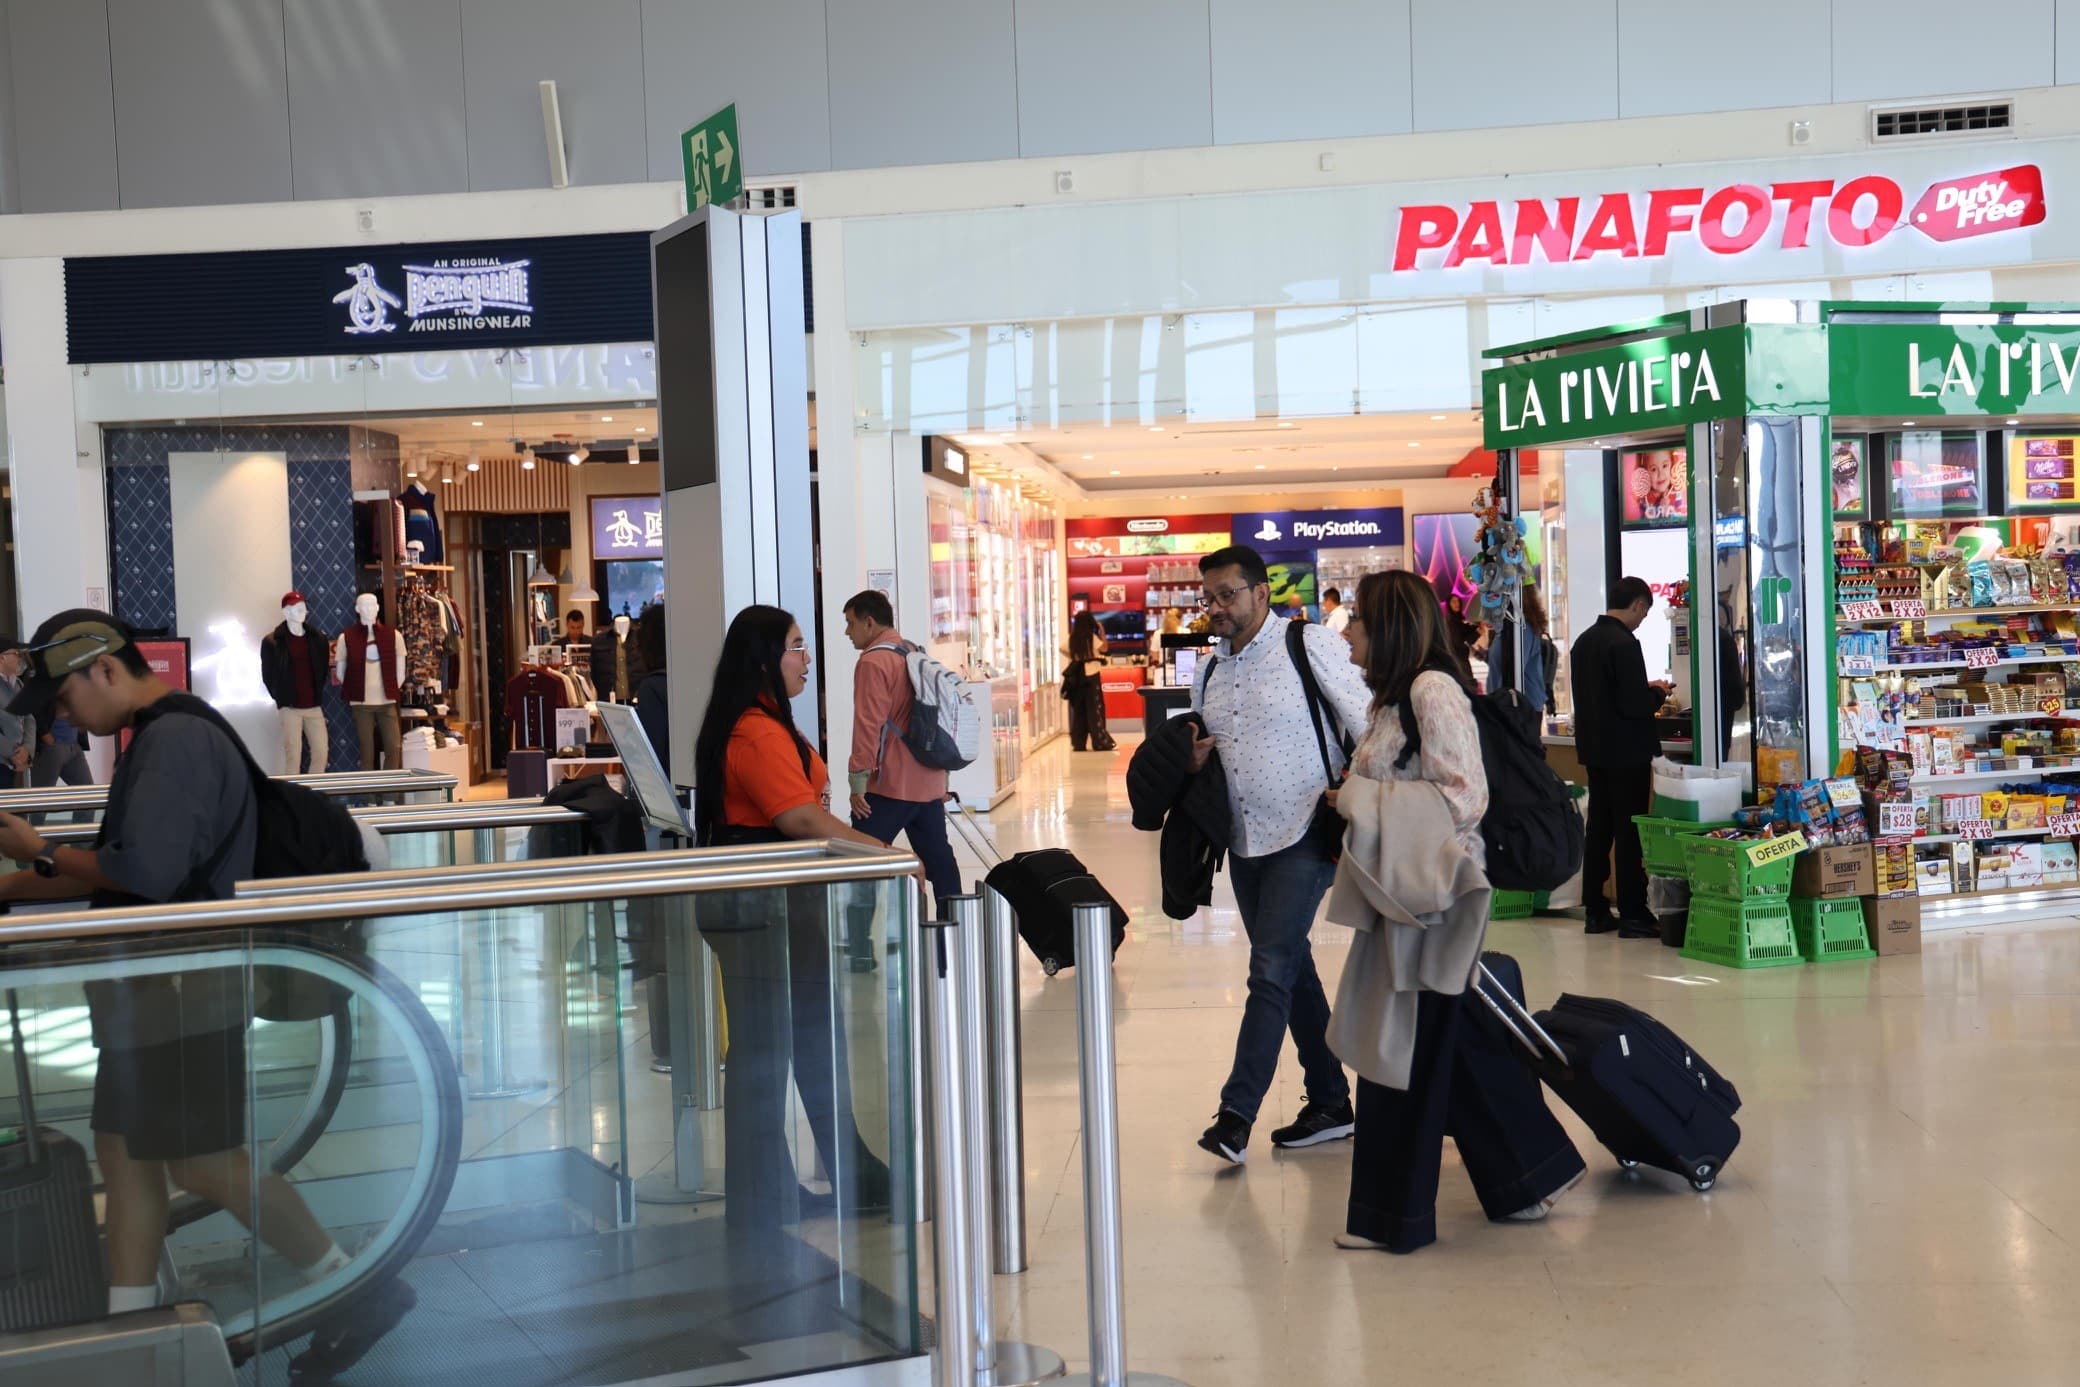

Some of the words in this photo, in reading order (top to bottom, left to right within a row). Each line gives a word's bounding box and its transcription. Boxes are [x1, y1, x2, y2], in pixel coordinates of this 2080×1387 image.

[1935, 180, 2009, 212] Duty
[1956, 199, 2026, 229] Free
[1393, 175, 1904, 271] PANAFOTO
[433, 259, 448, 268] AN
[452, 257, 501, 268] ORIGINAL
[408, 315, 532, 332] MUNSINGWEAR
[1909, 343, 1976, 397] LA
[1498, 378, 1546, 432] LA
[1846, 601, 1875, 611] OFERTA
[1893, 600, 1922, 608] OFERTA
[1849, 612, 1857, 620] 2
[1867, 607, 1881, 617] 12
[1894, 609, 1901, 617] 2
[1913, 608, 1926, 617] 20
[1966, 648, 1995, 658] OFERTA
[1968, 658, 1975, 667] 2
[1986, 656, 1998, 665] 20
[1893, 813, 1912, 827] $28
[1960, 820, 1990, 828] OFERTA
[1960, 830, 1968, 838] 2
[1981, 829, 1993, 838] 18
[1755, 838, 1801, 861] OFERTA
